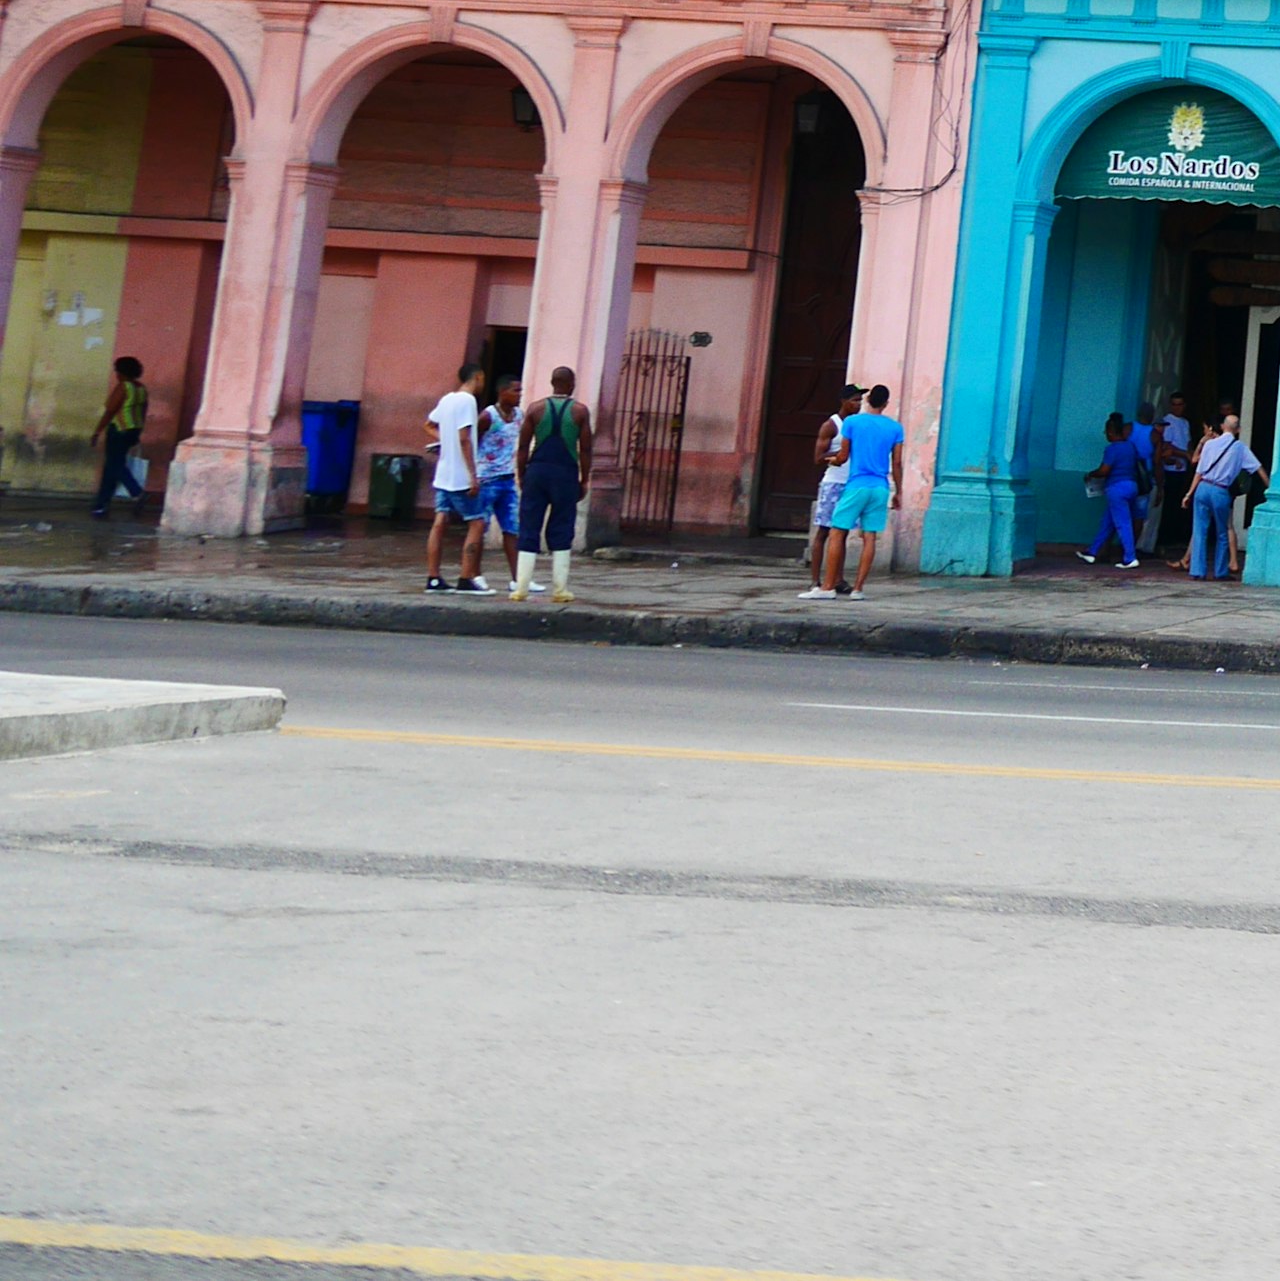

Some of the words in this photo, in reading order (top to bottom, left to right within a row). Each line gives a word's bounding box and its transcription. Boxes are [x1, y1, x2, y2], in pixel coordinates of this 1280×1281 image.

[1107, 151, 1158, 174] Los
[1159, 152, 1260, 179] Nardos
[1108, 177, 1140, 186] COMIDA
[1141, 176, 1182, 188] ESPAÑOLA
[1183, 180, 1191, 188] &
[1192, 180, 1255, 192] INTERNACIONAL
